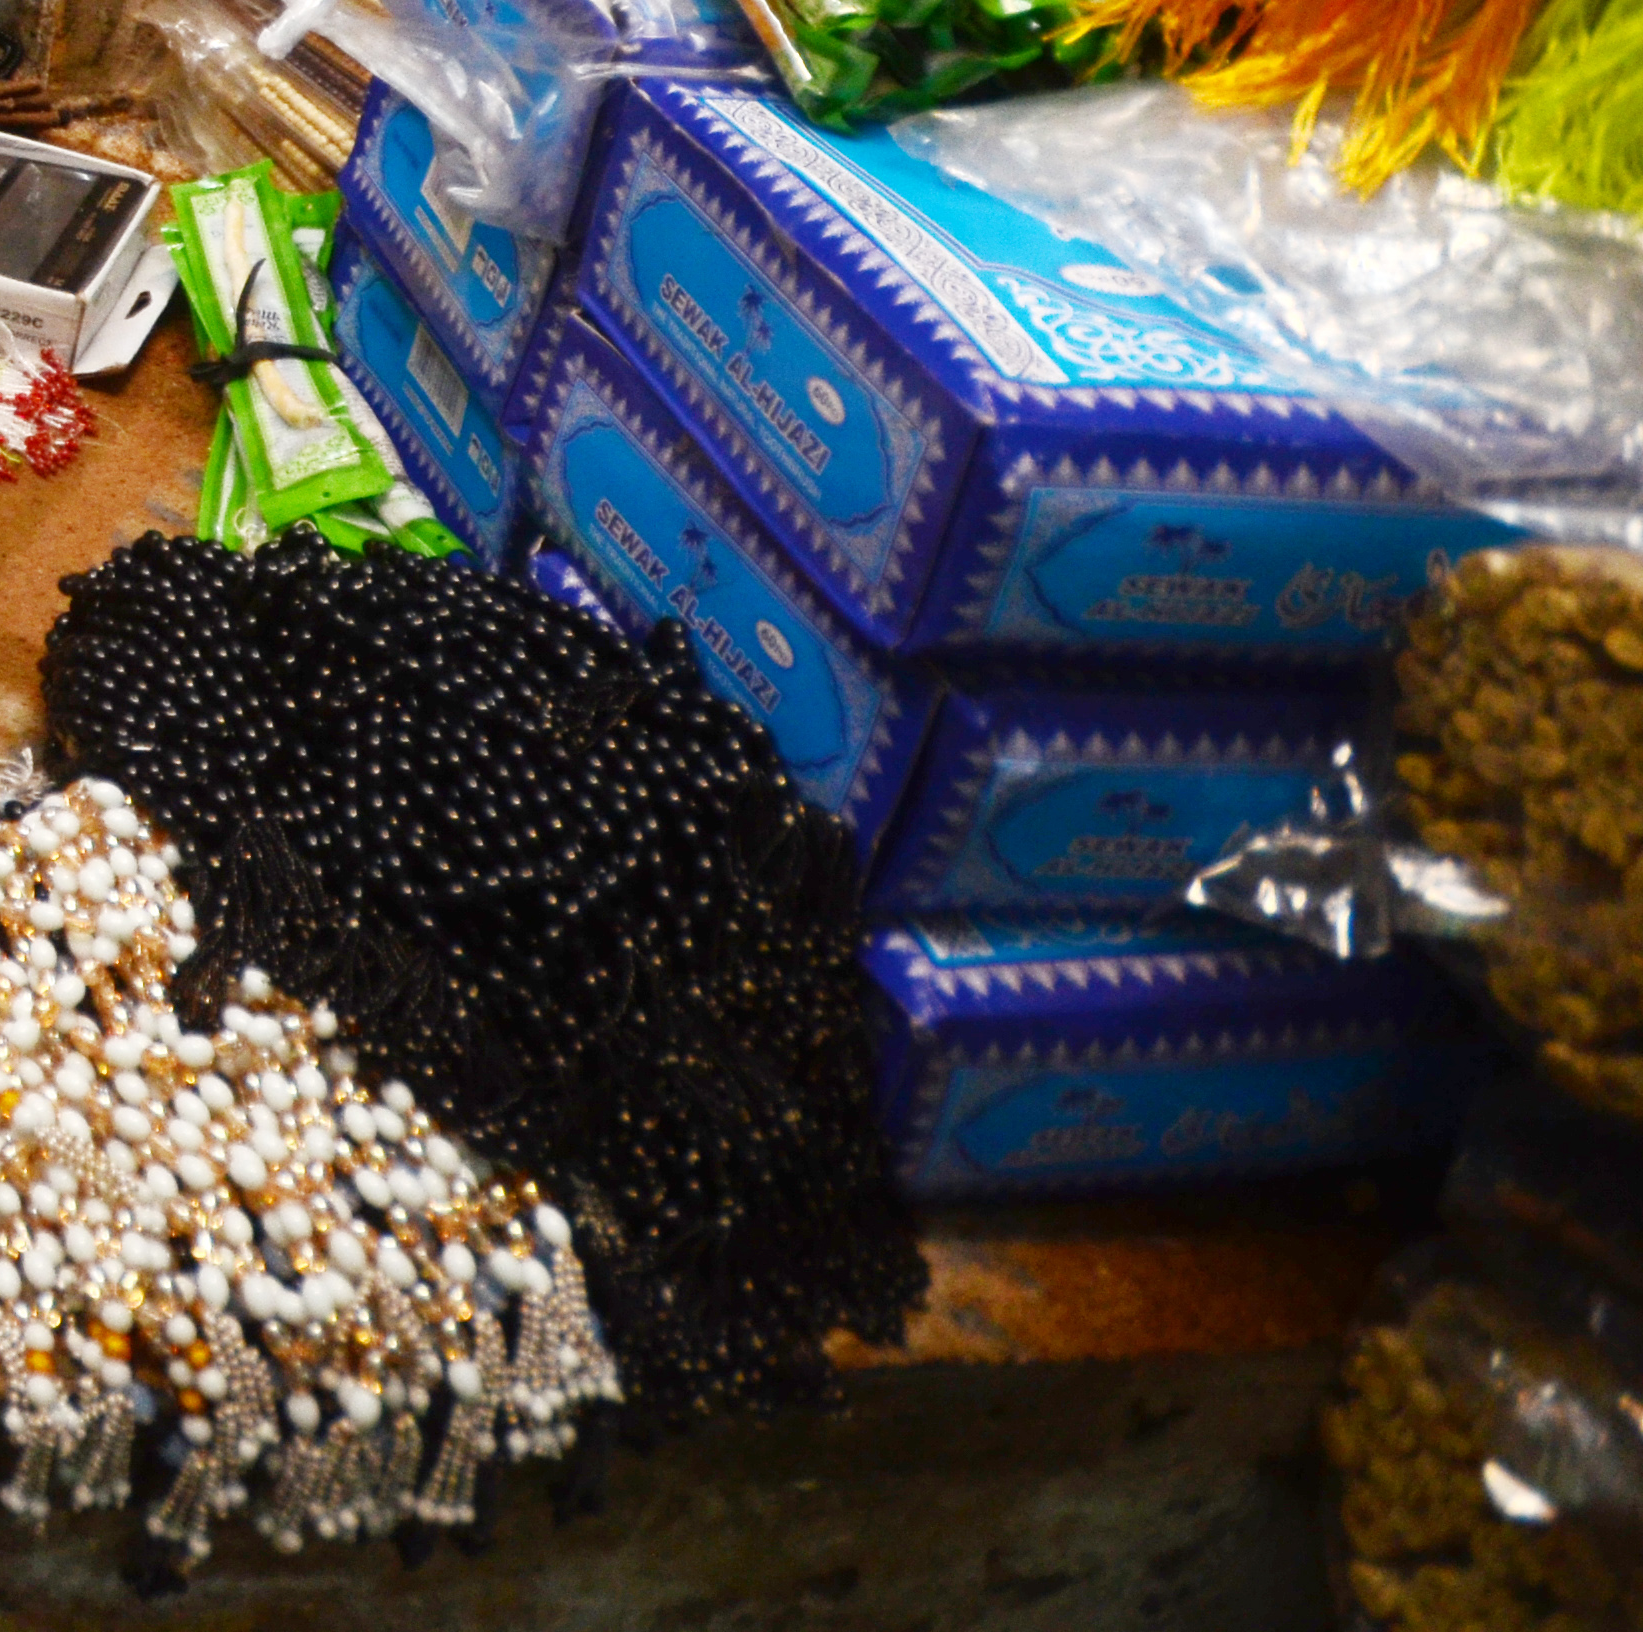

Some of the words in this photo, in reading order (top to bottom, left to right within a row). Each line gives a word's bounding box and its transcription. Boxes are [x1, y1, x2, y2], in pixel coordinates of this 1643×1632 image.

[659, 273, 730, 361] SEWAK
[724, 351, 832, 475] AL-HIJAZI
[595, 498, 670, 592] SEWAK
[666, 584, 782, 714] AL-HIJAZI
